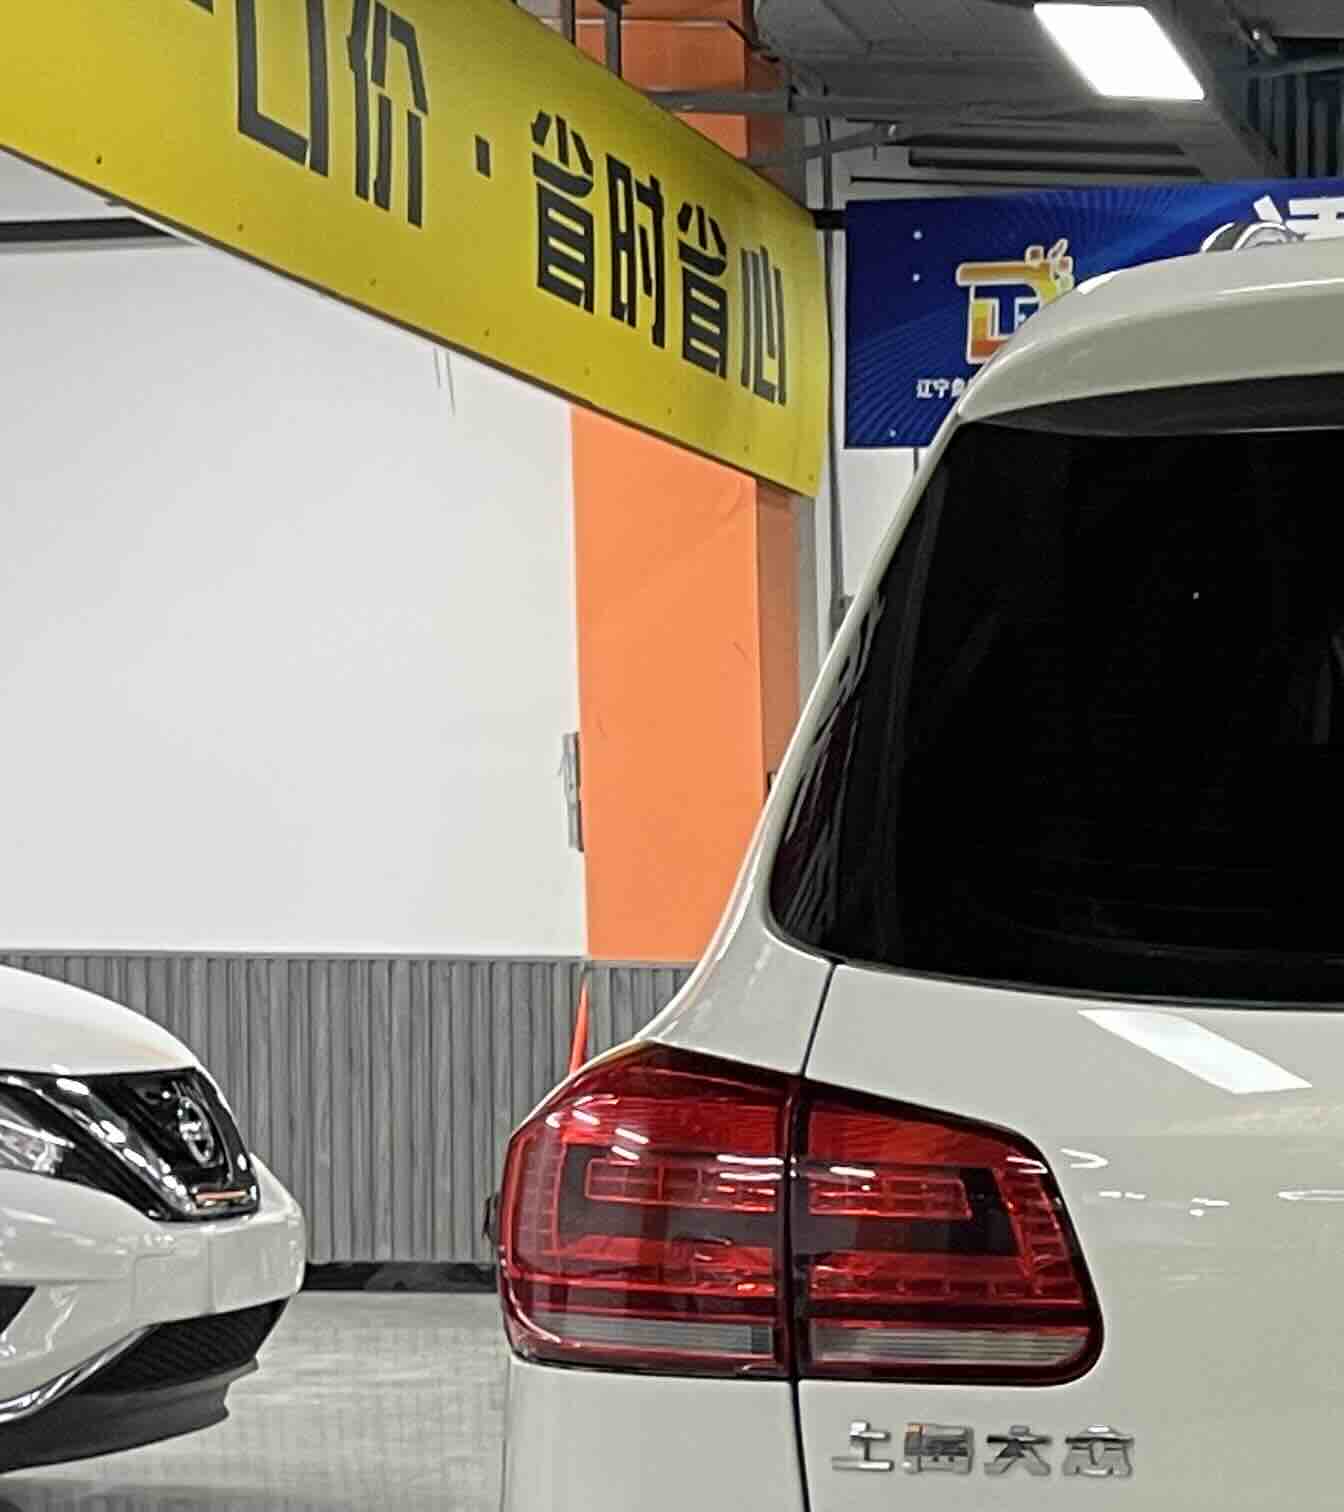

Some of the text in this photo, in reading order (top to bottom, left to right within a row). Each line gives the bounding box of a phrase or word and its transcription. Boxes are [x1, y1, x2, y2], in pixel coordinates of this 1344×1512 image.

[187, 0, 787, 406] 口价·省时省心
